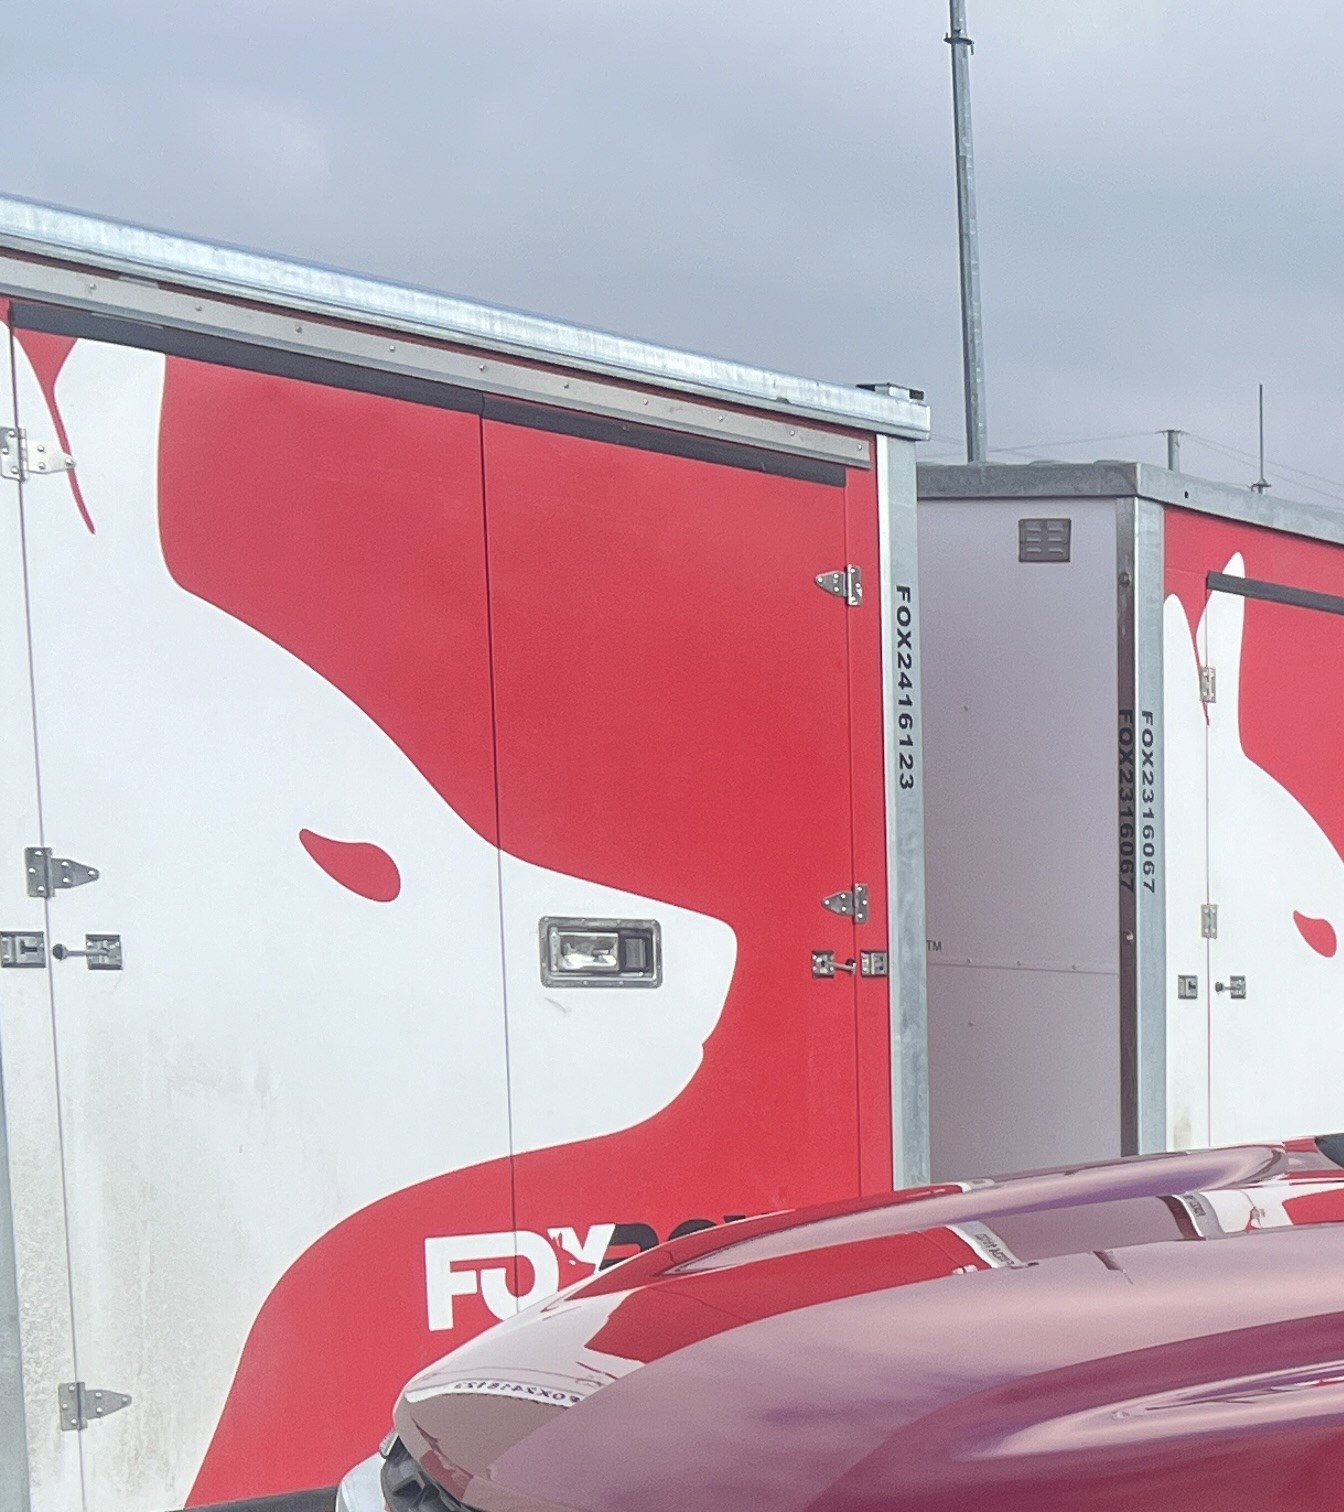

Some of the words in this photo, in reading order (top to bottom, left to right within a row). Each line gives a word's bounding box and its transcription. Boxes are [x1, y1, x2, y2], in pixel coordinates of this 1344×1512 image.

[895, 584, 914, 790] FOX2416123
[1118, 708, 1136, 894] FOX2316067
[1141, 710, 1156, 895] FOX2316067
